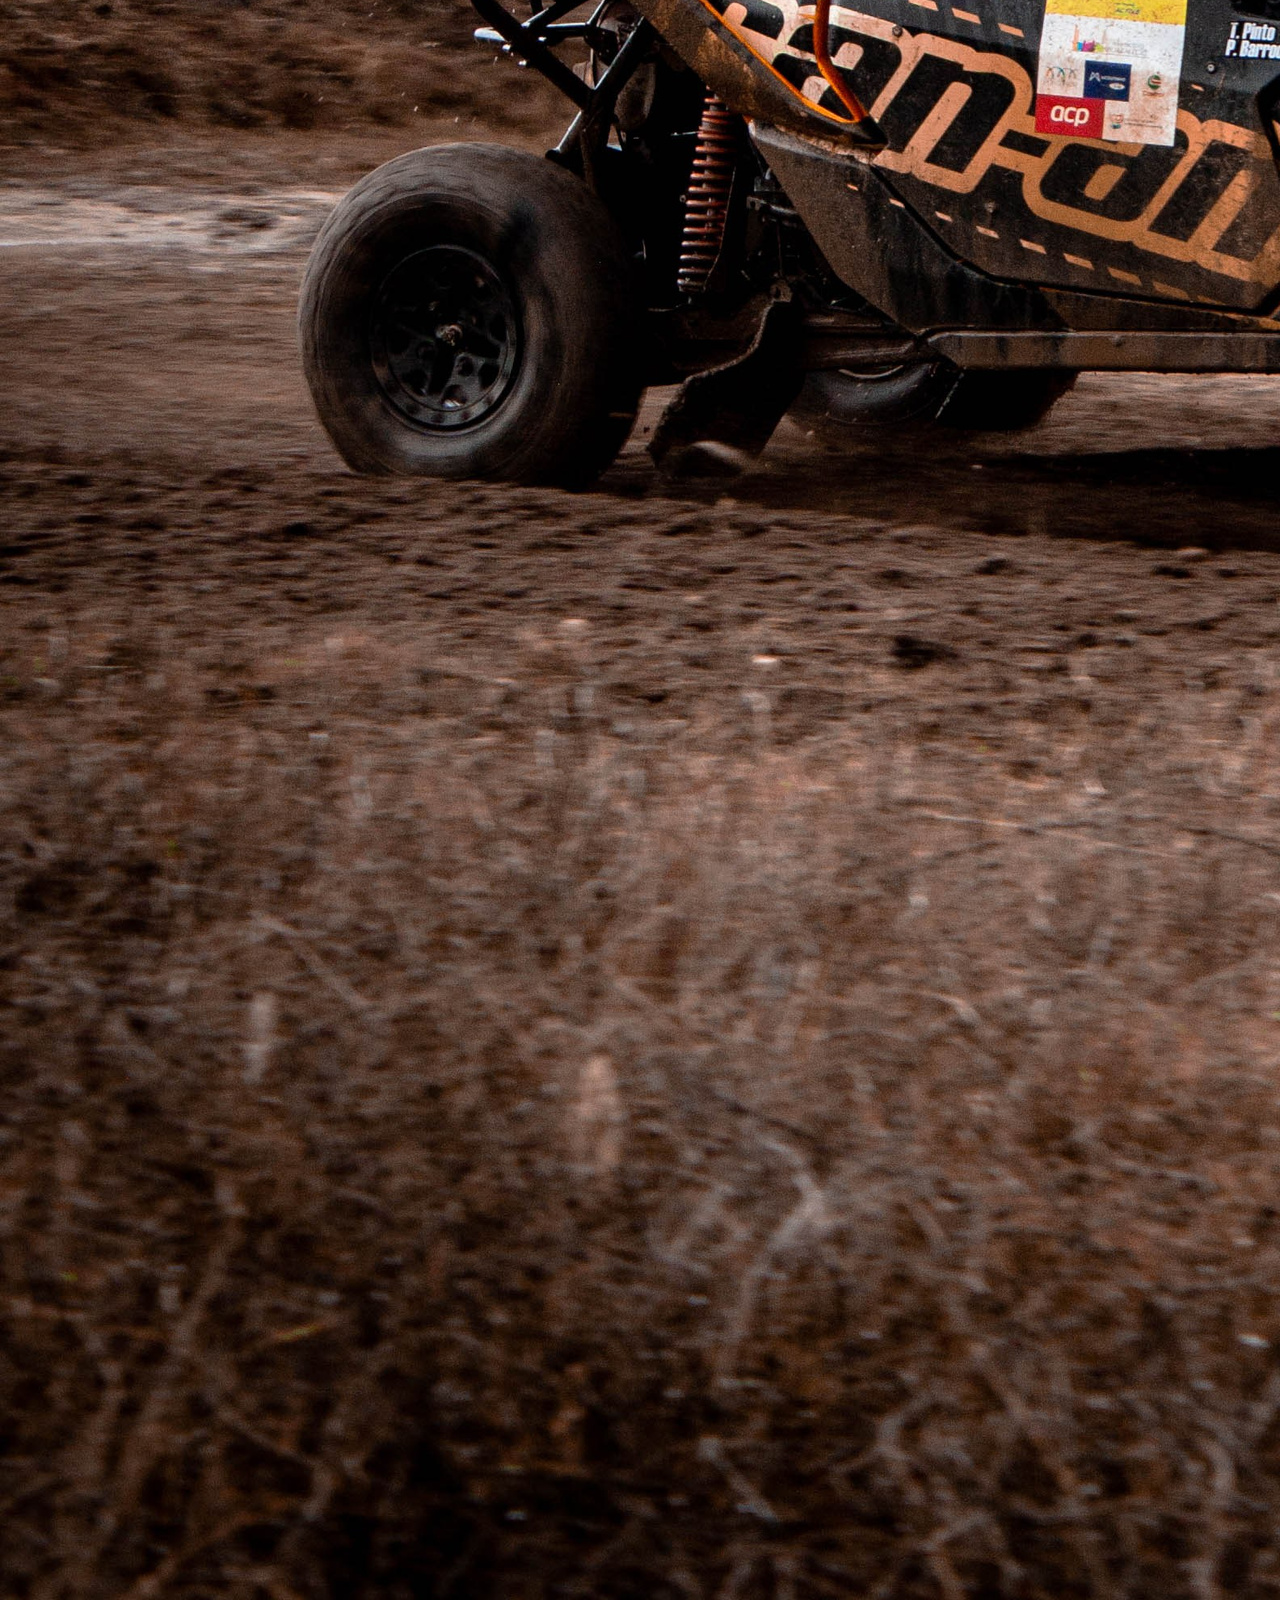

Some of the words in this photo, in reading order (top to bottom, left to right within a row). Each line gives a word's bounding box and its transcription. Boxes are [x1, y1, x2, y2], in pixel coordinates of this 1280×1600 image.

[1230, 22, 1240, 39] T.
[1242, 22, 1276, 41] Pinto
[1225, 38, 1237, 56] P.
[1051, 105, 1089, 127] acp
